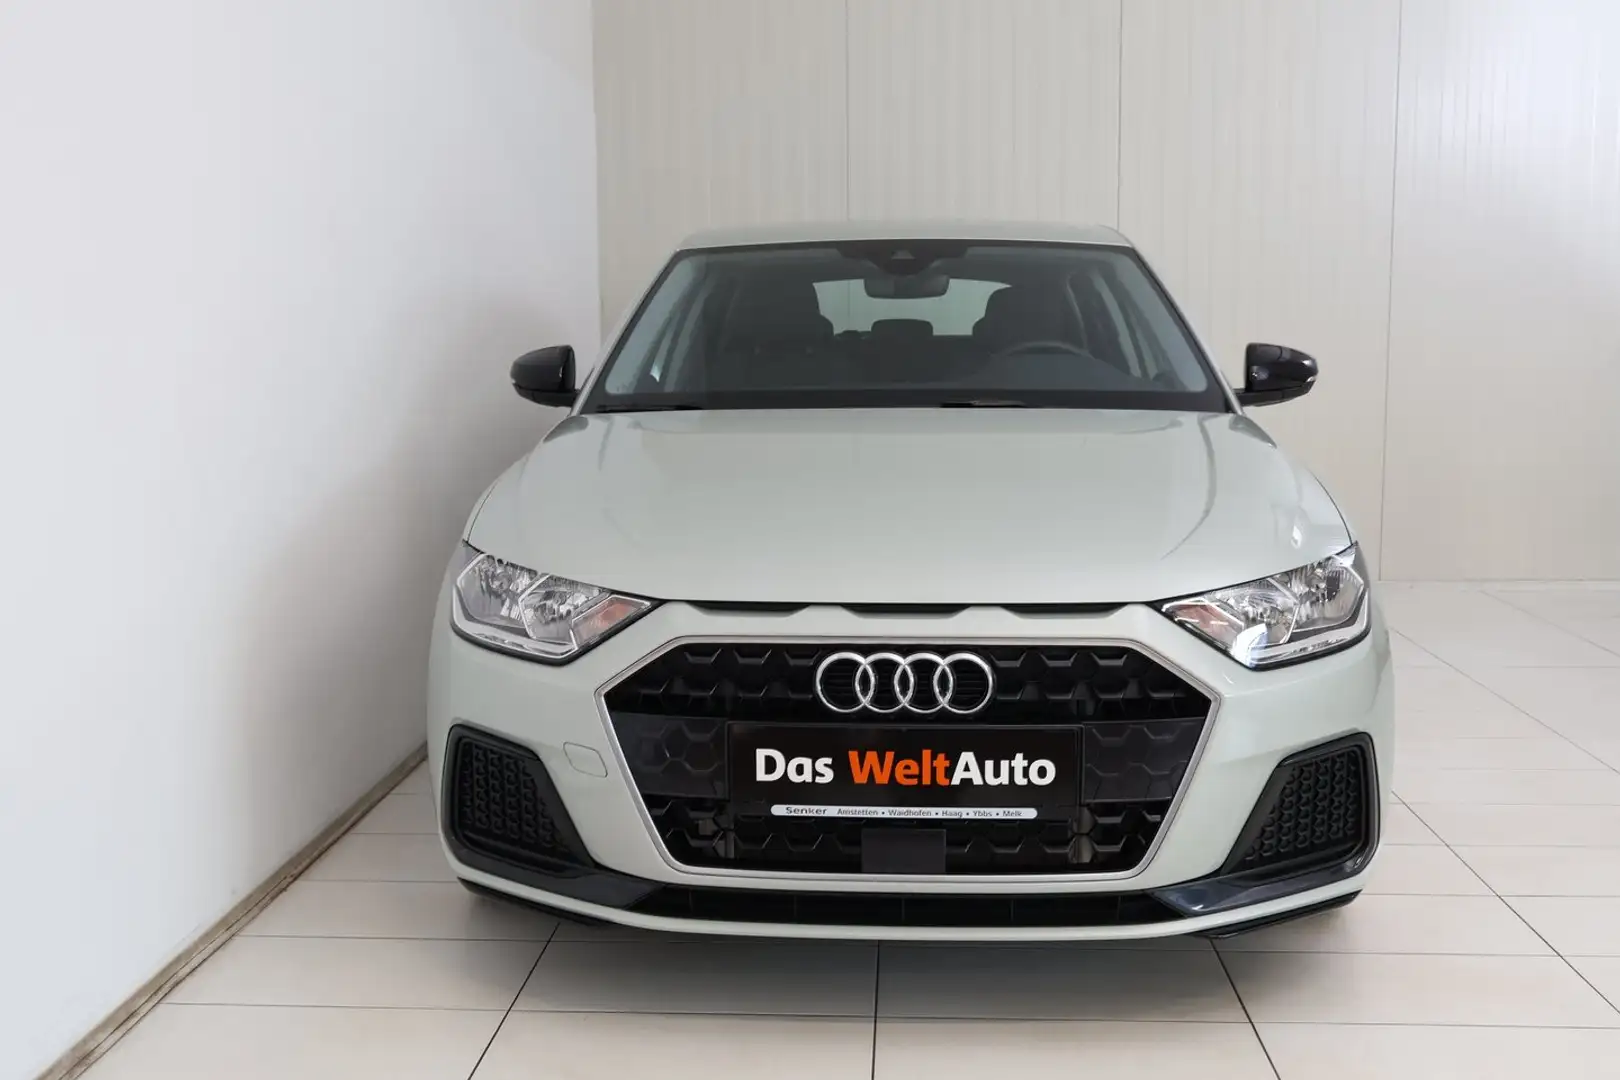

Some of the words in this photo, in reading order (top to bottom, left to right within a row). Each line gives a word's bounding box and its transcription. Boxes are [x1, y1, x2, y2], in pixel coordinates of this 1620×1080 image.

[755, 747, 834, 784] Das
[848, 749, 1056, 787] WeltAuto
[785, 806, 828, 815] Senker
[837, 807, 879, 817] Amstetten
[888, 808, 932, 817] Waidhofen
[941, 809, 963, 819] Haag
[972, 809, 993, 818] Ybbs
[1002, 810, 1022, 818] Melk
